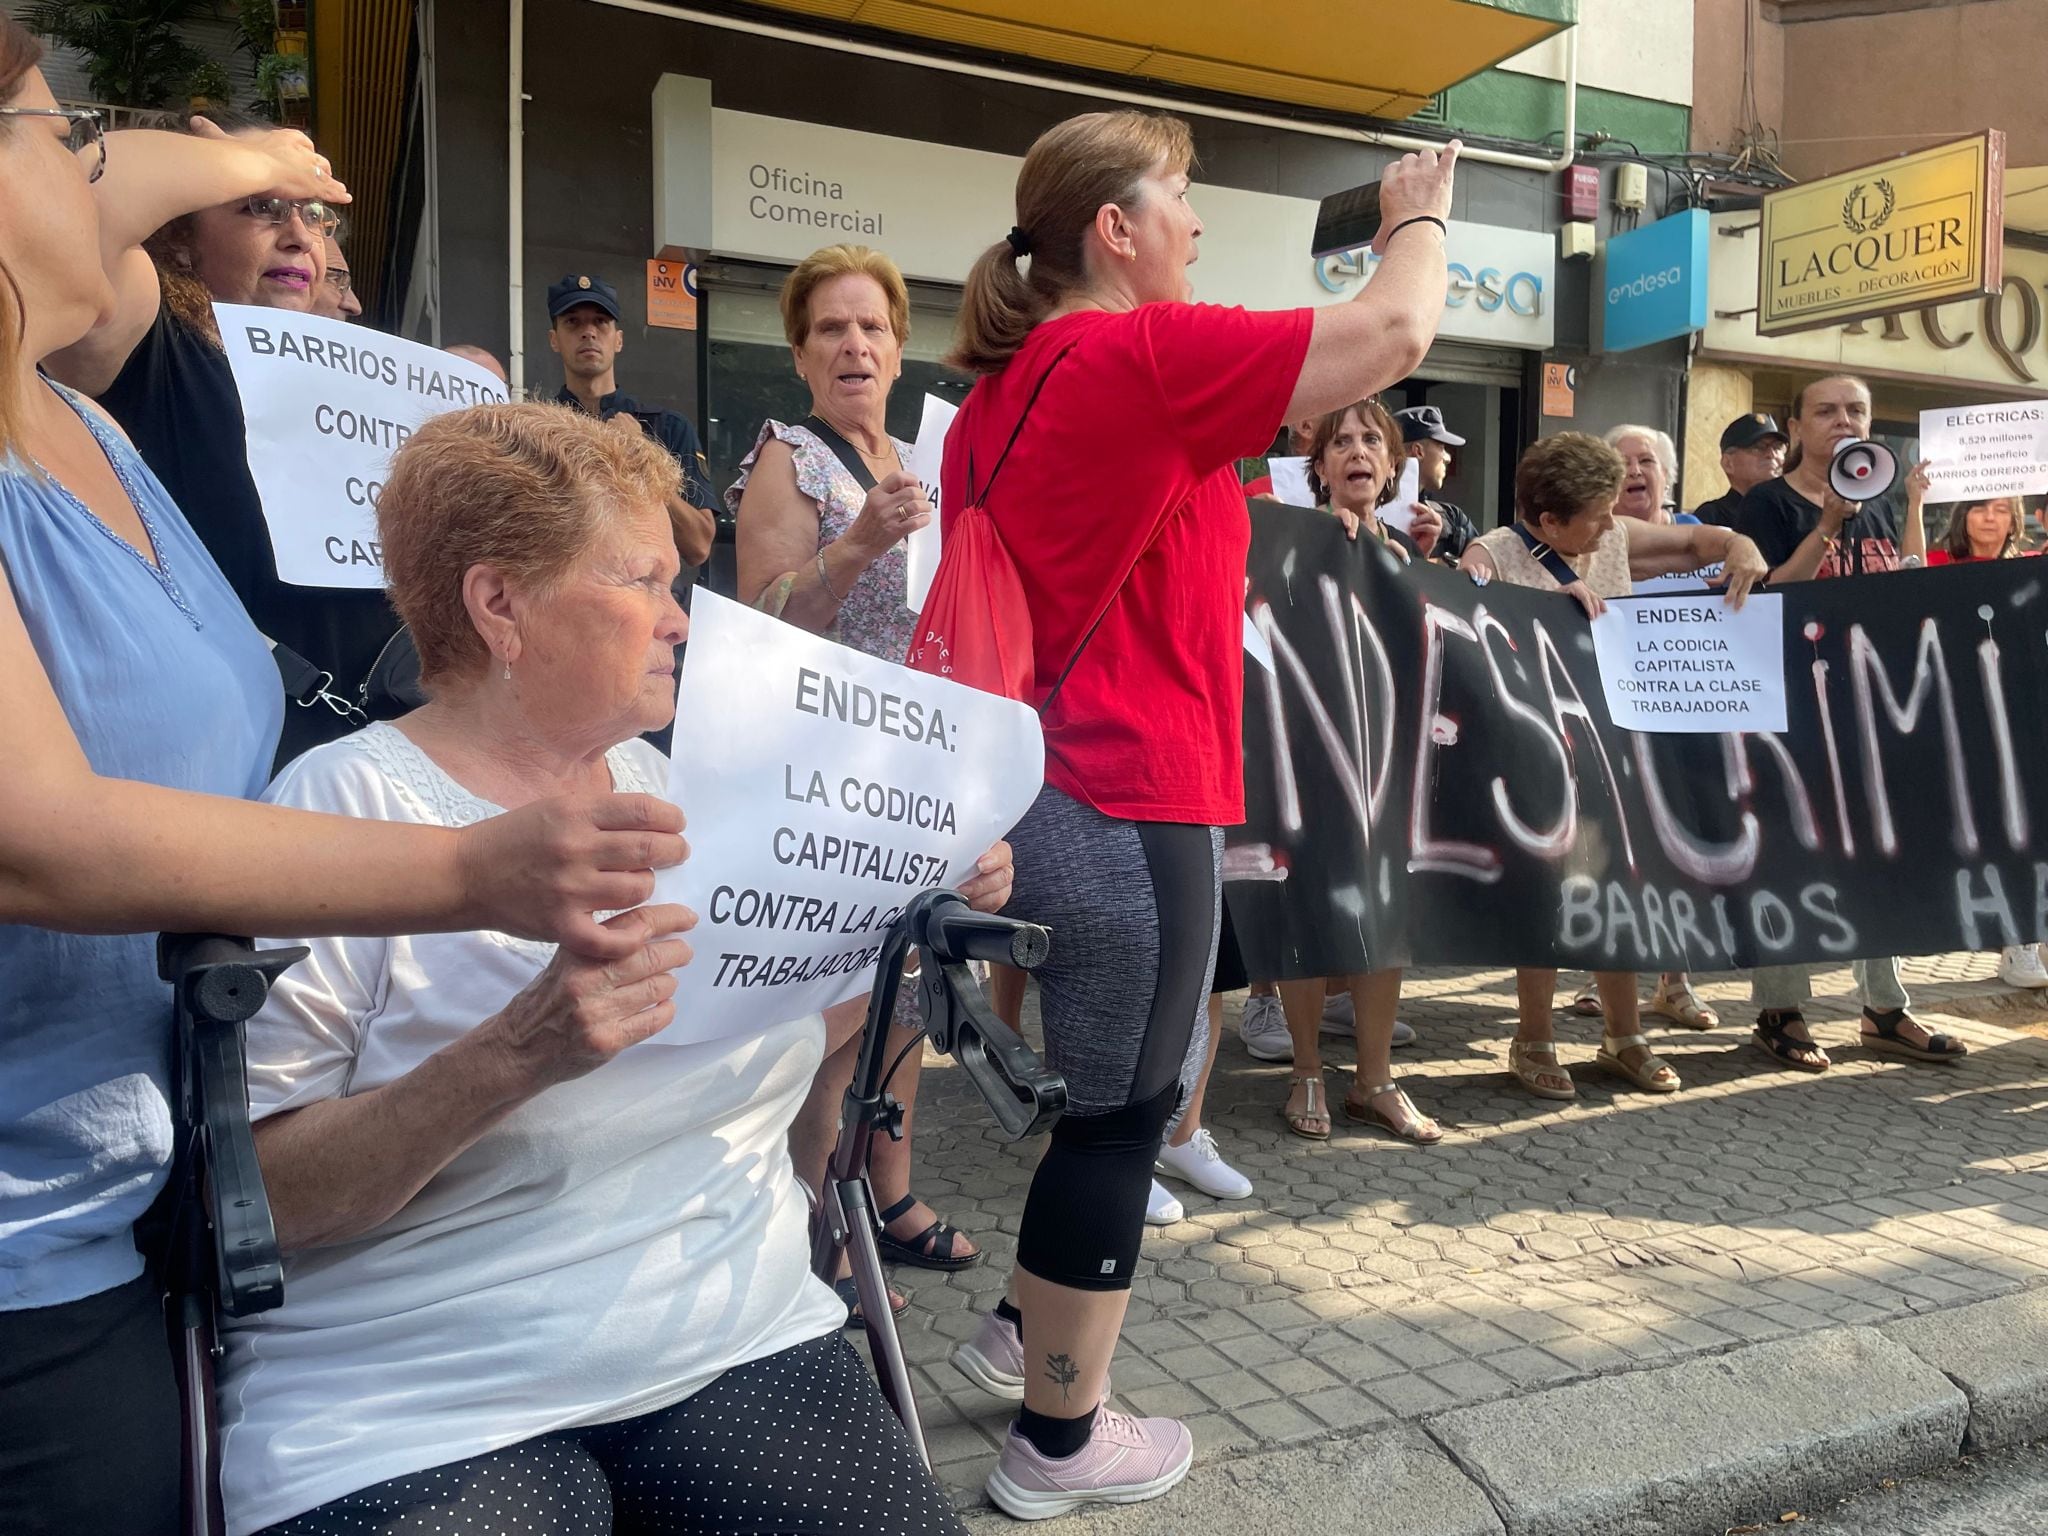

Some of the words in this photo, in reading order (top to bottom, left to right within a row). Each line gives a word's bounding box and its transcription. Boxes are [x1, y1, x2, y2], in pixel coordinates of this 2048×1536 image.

[749, 164, 843, 200] Oficina
[749, 195, 883, 235] Comercial
[1859, 195, 1878, 220] L
[1779, 216, 1964, 289] LACQUER
[1315, 250, 1544, 318] enesa
[1608, 264, 1681, 305] endesa
[1776, 286, 1841, 311] MUEBLES
[1858, 258, 1961, 294] DECORACIÓN
[245, 326, 397, 386] BARRIOS
[1946, 409, 2044, 427] ELÉCTRICAS:
[1964, 453, 1977, 462] de
[1980, 450, 2028, 460] beneficio
[1989, 433, 2033, 444] millones
[1636, 608, 1723, 624] ENDESA:
[1637, 641, 1658, 652] LA
[1663, 639, 1728, 652] CODICIA
[1617, 679, 1680, 693] CONTRA
[1684, 680, 1704, 693] LA
[1709, 680, 1762, 692] CLASE
[1634, 660, 1735, 673] CAPITALISTA
[796, 666, 957, 753] ENDESA:
[1631, 700, 1750, 713] TRABAJADORA
[1224, 574, 1640, 884] NDESA
[785, 764, 830, 808] LA
[840, 777, 956, 836] CODICIA
[773, 827, 949, 888] CAPITALISTA
[709, 885, 838, 934] CONTRA
[840, 903, 878, 934] LA
[1556, 870, 1858, 962] BARRIOS
